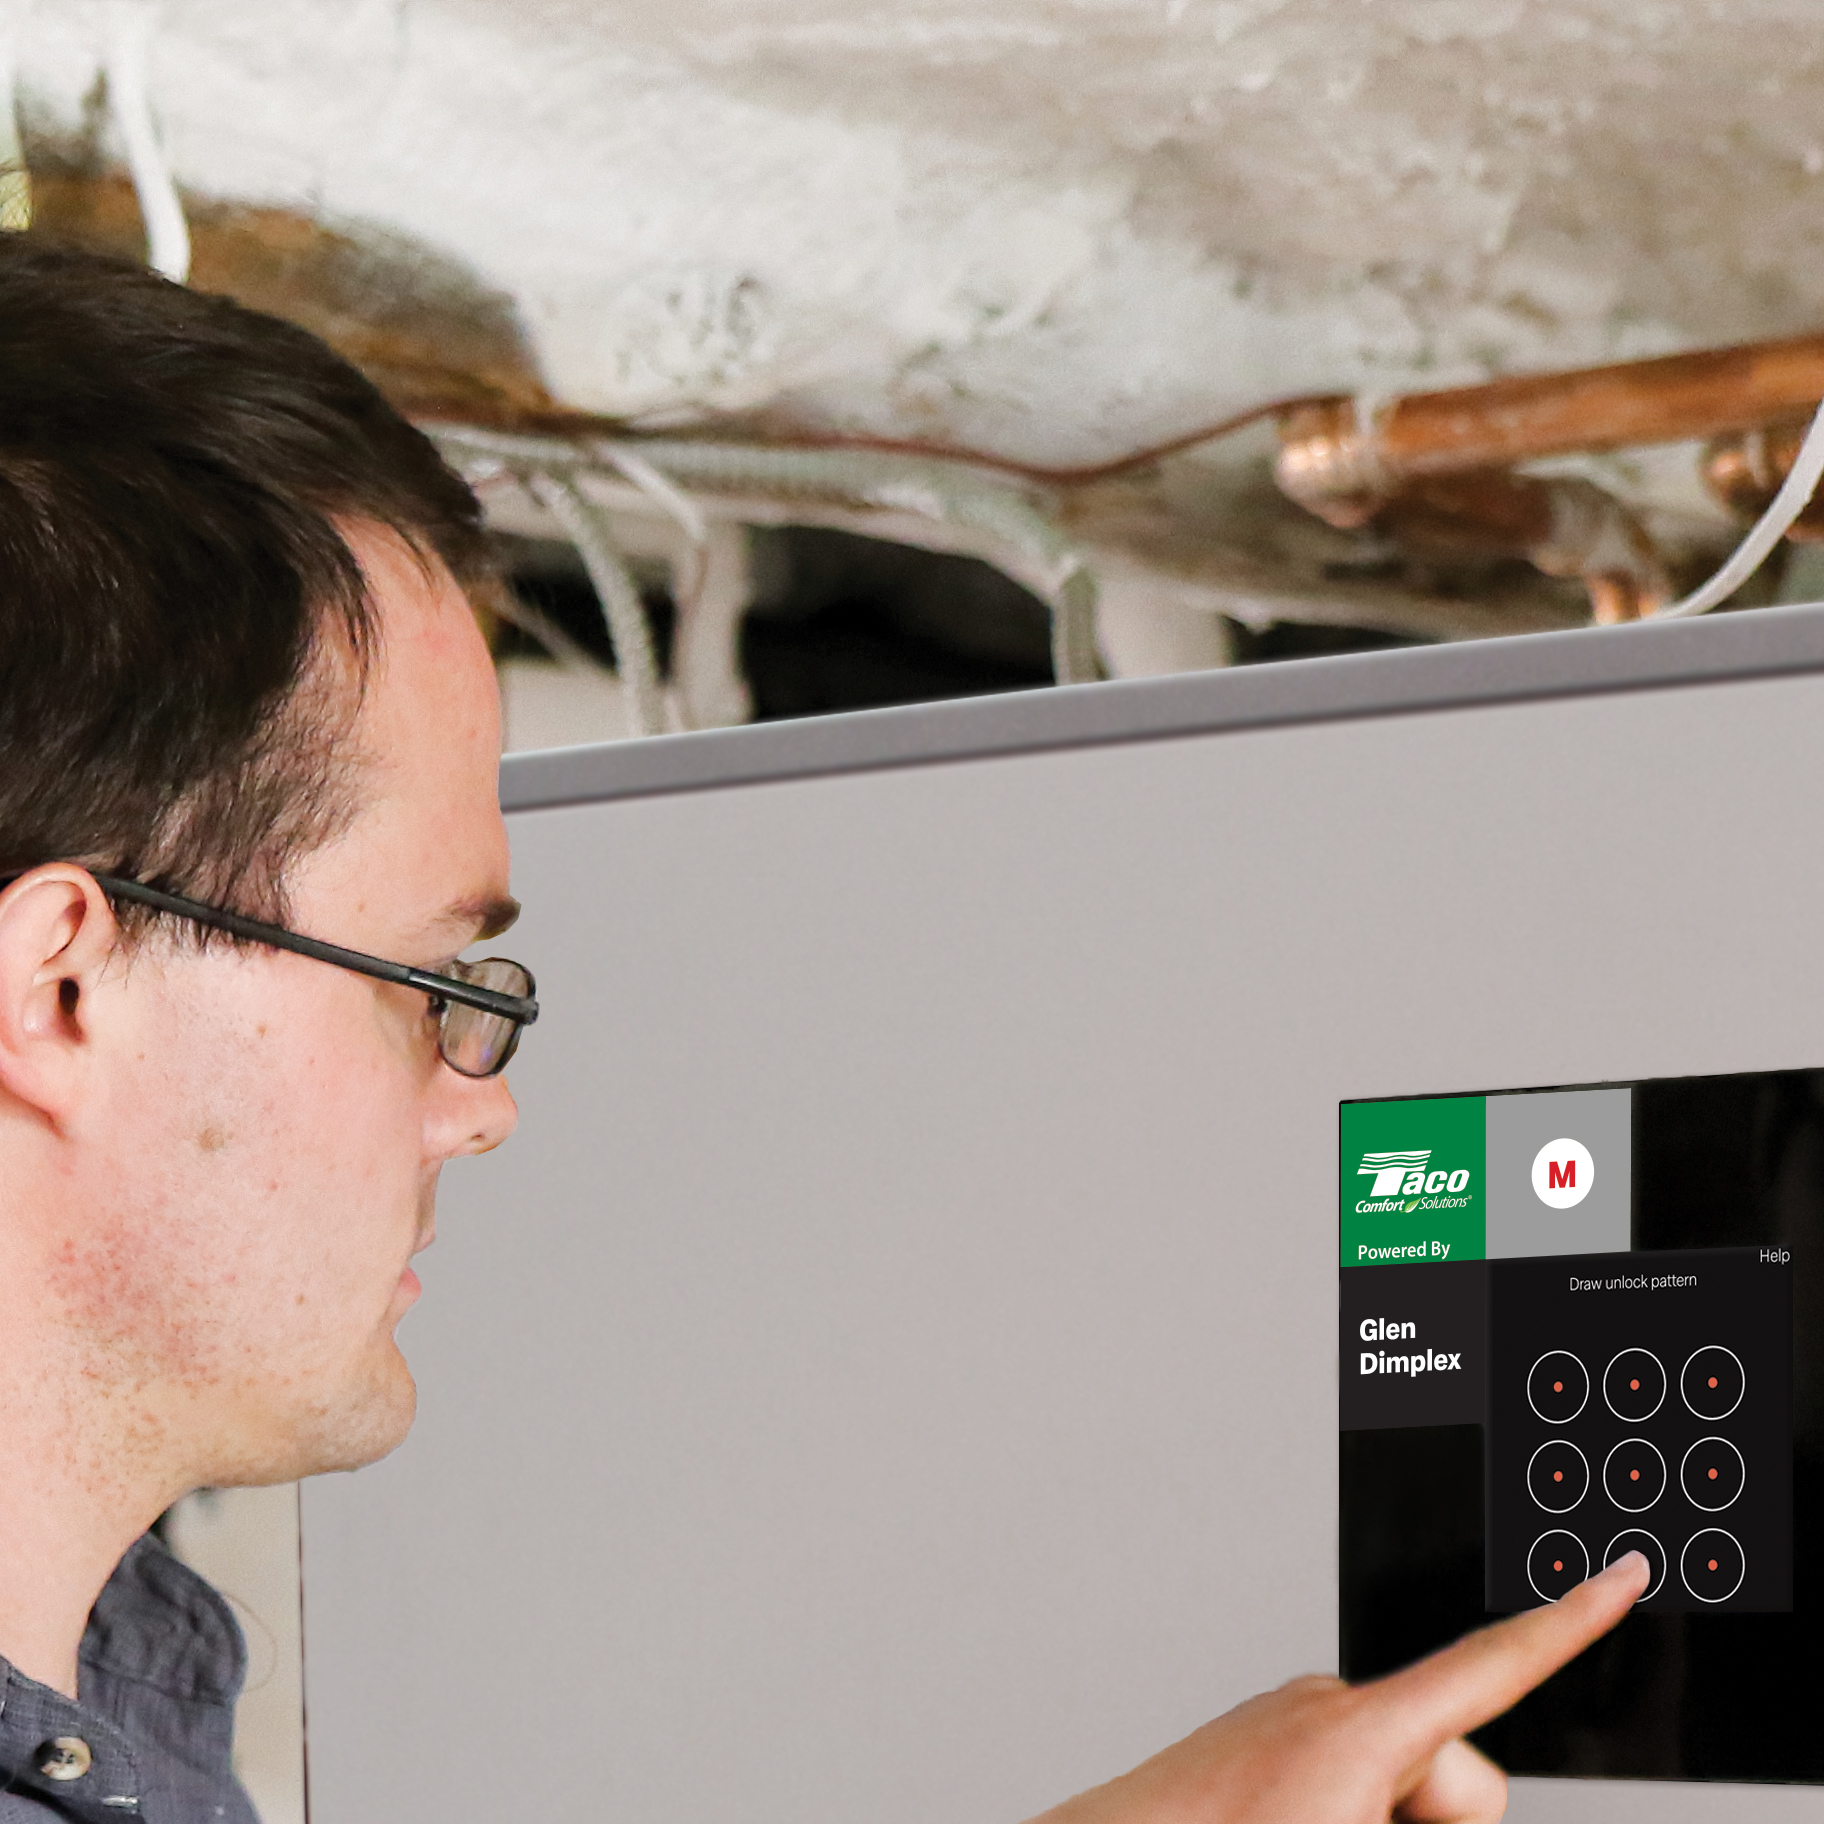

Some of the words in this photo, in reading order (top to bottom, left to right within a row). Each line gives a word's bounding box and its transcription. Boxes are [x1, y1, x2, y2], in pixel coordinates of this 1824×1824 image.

[1357, 1150, 1471, 1197] Taco
[1548, 1160, 1576, 1189] M
[1355, 1198, 1405, 1213] Comfort
[1358, 1241, 1427, 1260] Powered
[1431, 1241, 1451, 1260] By
[1760, 1248, 1791, 1265] Help
[1569, 1276, 1602, 1292] Draw
[1605, 1274, 1648, 1290] unlock
[1652, 1272, 1697, 1290] pattern
[1360, 1318, 1416, 1342] Glen
[1360, 1348, 1462, 1377] Dimplex
